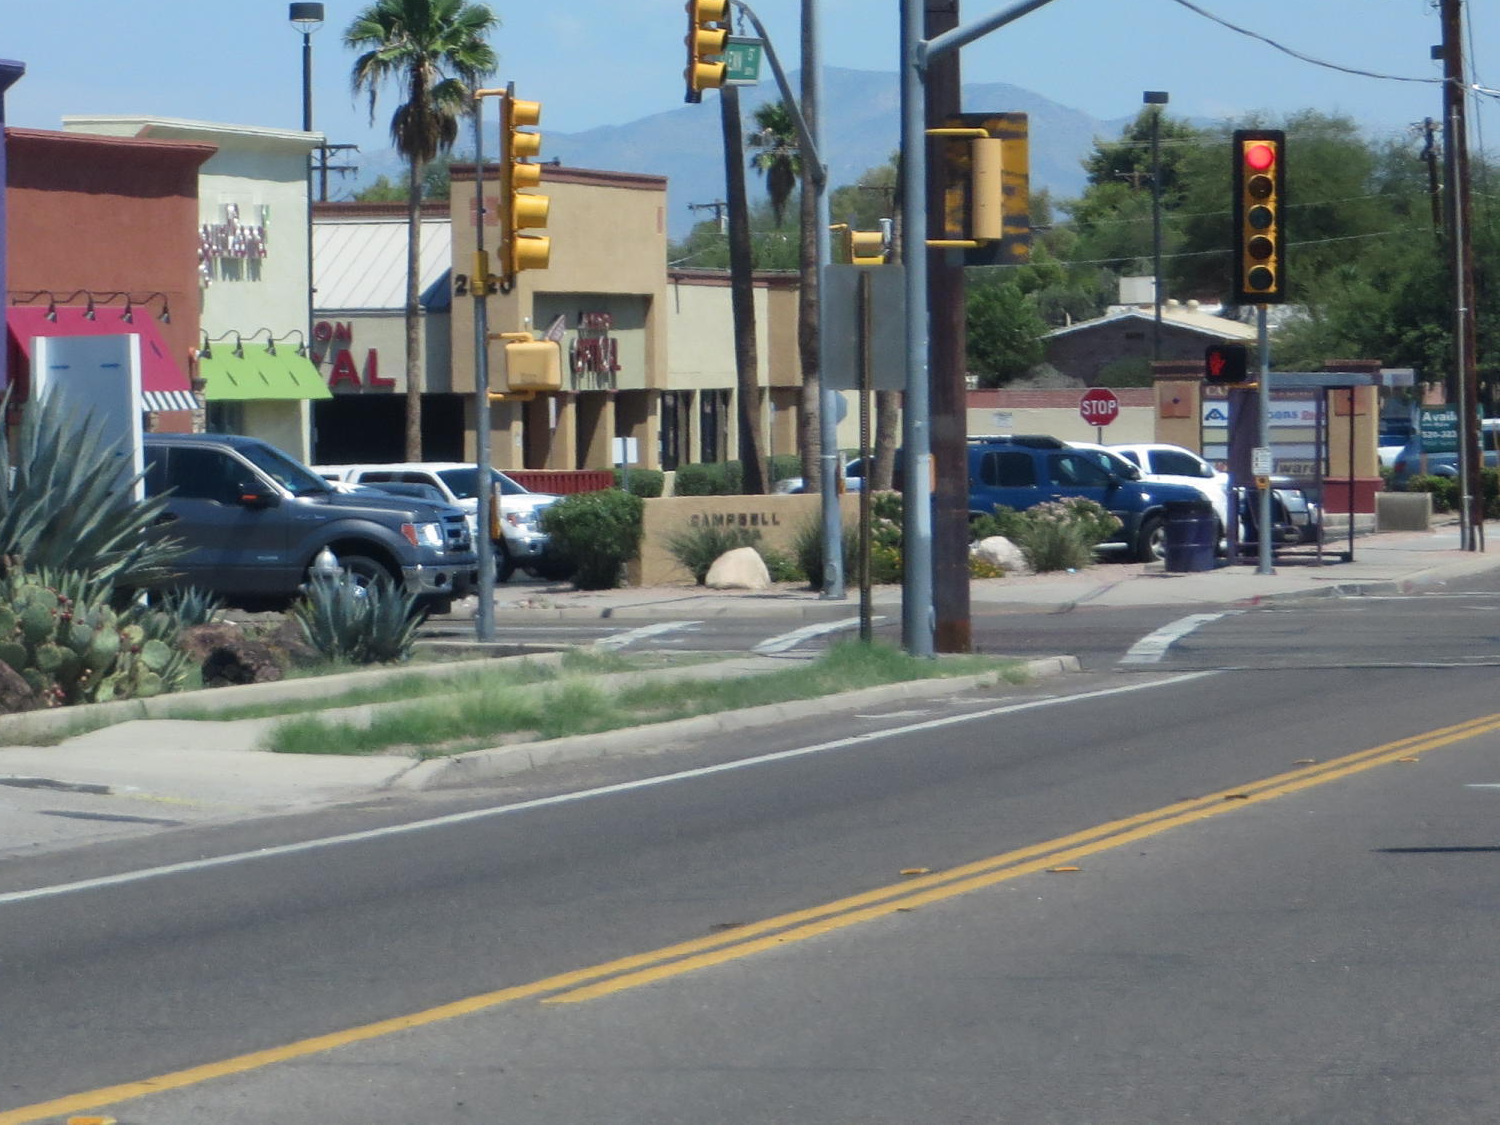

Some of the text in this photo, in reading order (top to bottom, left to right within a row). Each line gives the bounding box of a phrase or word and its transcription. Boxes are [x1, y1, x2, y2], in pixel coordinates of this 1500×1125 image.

[455, 274, 515, 296] 220
[1082, 400, 1116, 415] STOP
[691, 512, 781, 527] CAMPBELL
